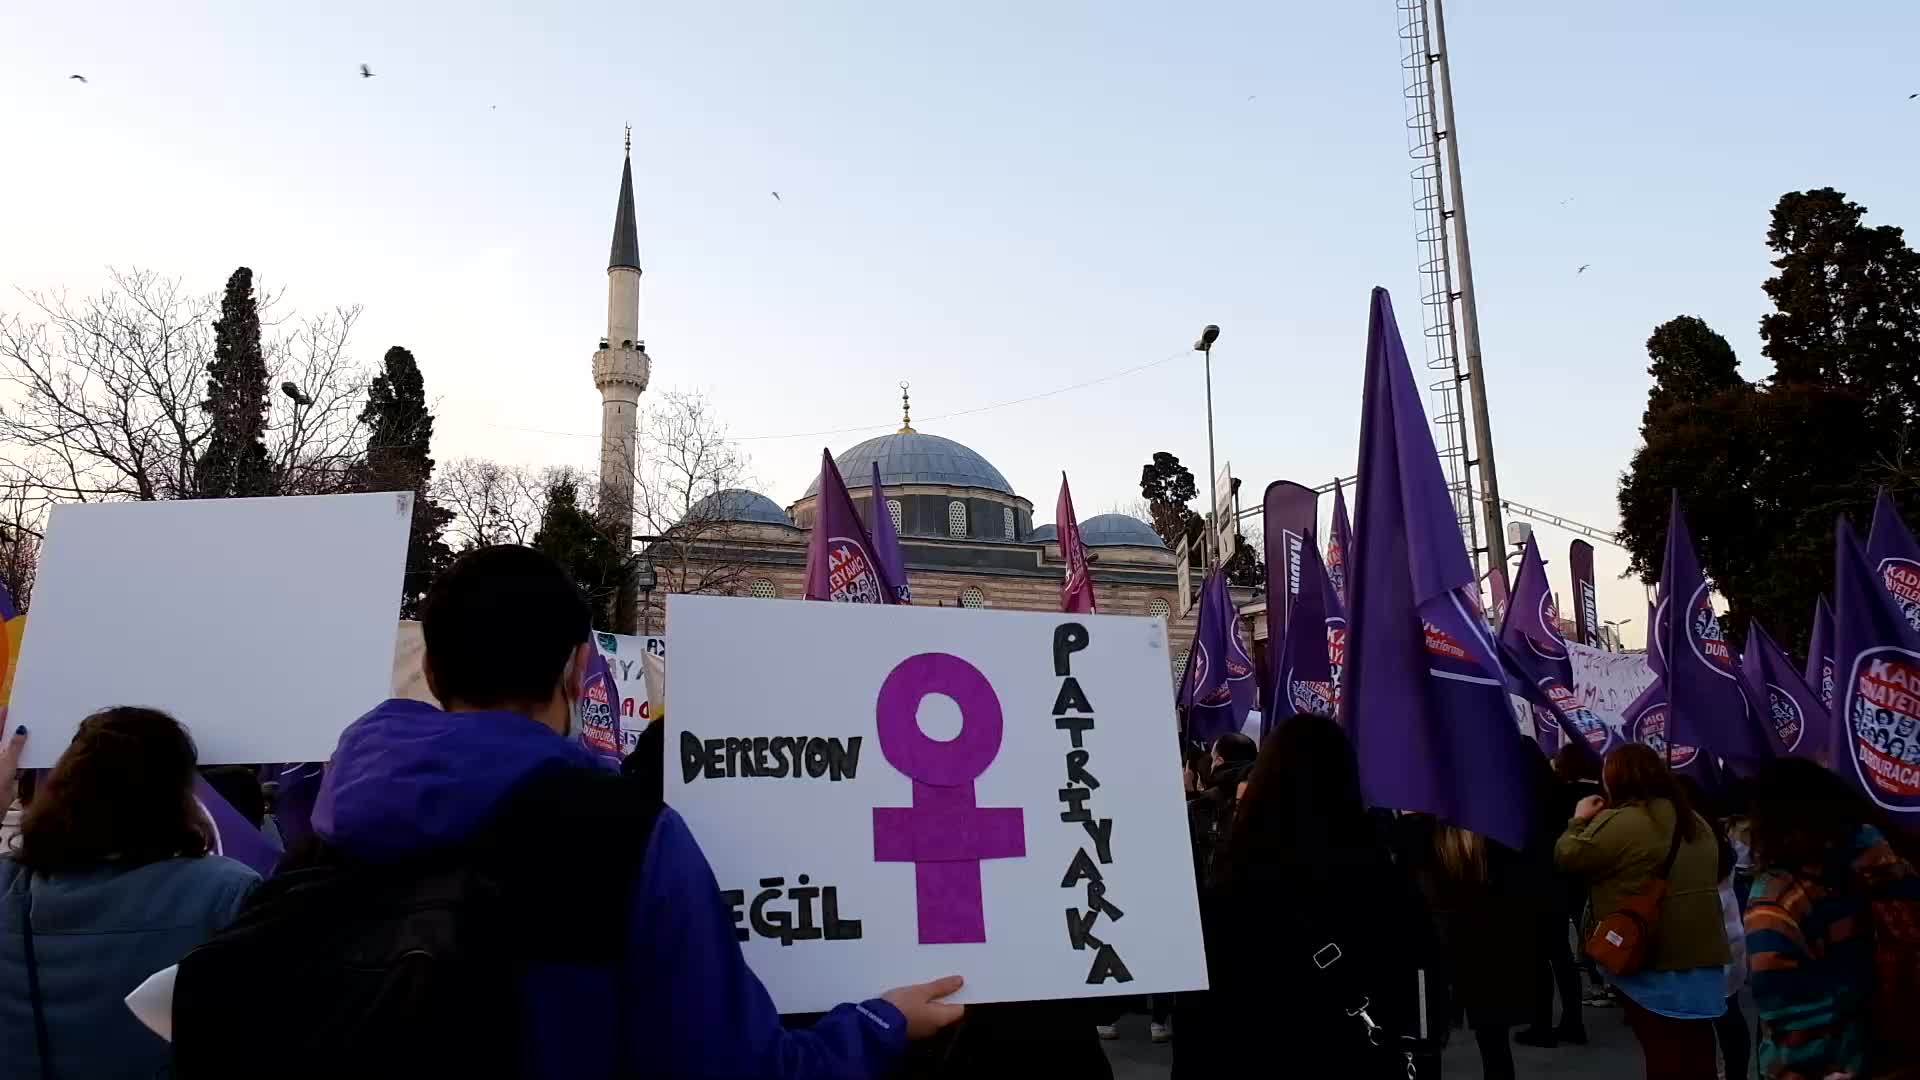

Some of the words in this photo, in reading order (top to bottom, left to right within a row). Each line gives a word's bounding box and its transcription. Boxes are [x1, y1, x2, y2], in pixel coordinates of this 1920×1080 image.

[680, 731, 863, 784] DEPRESYON
[1052, 622, 1134, 985] PATRİYARKA
[718, 873, 862, 947] EĞİL
